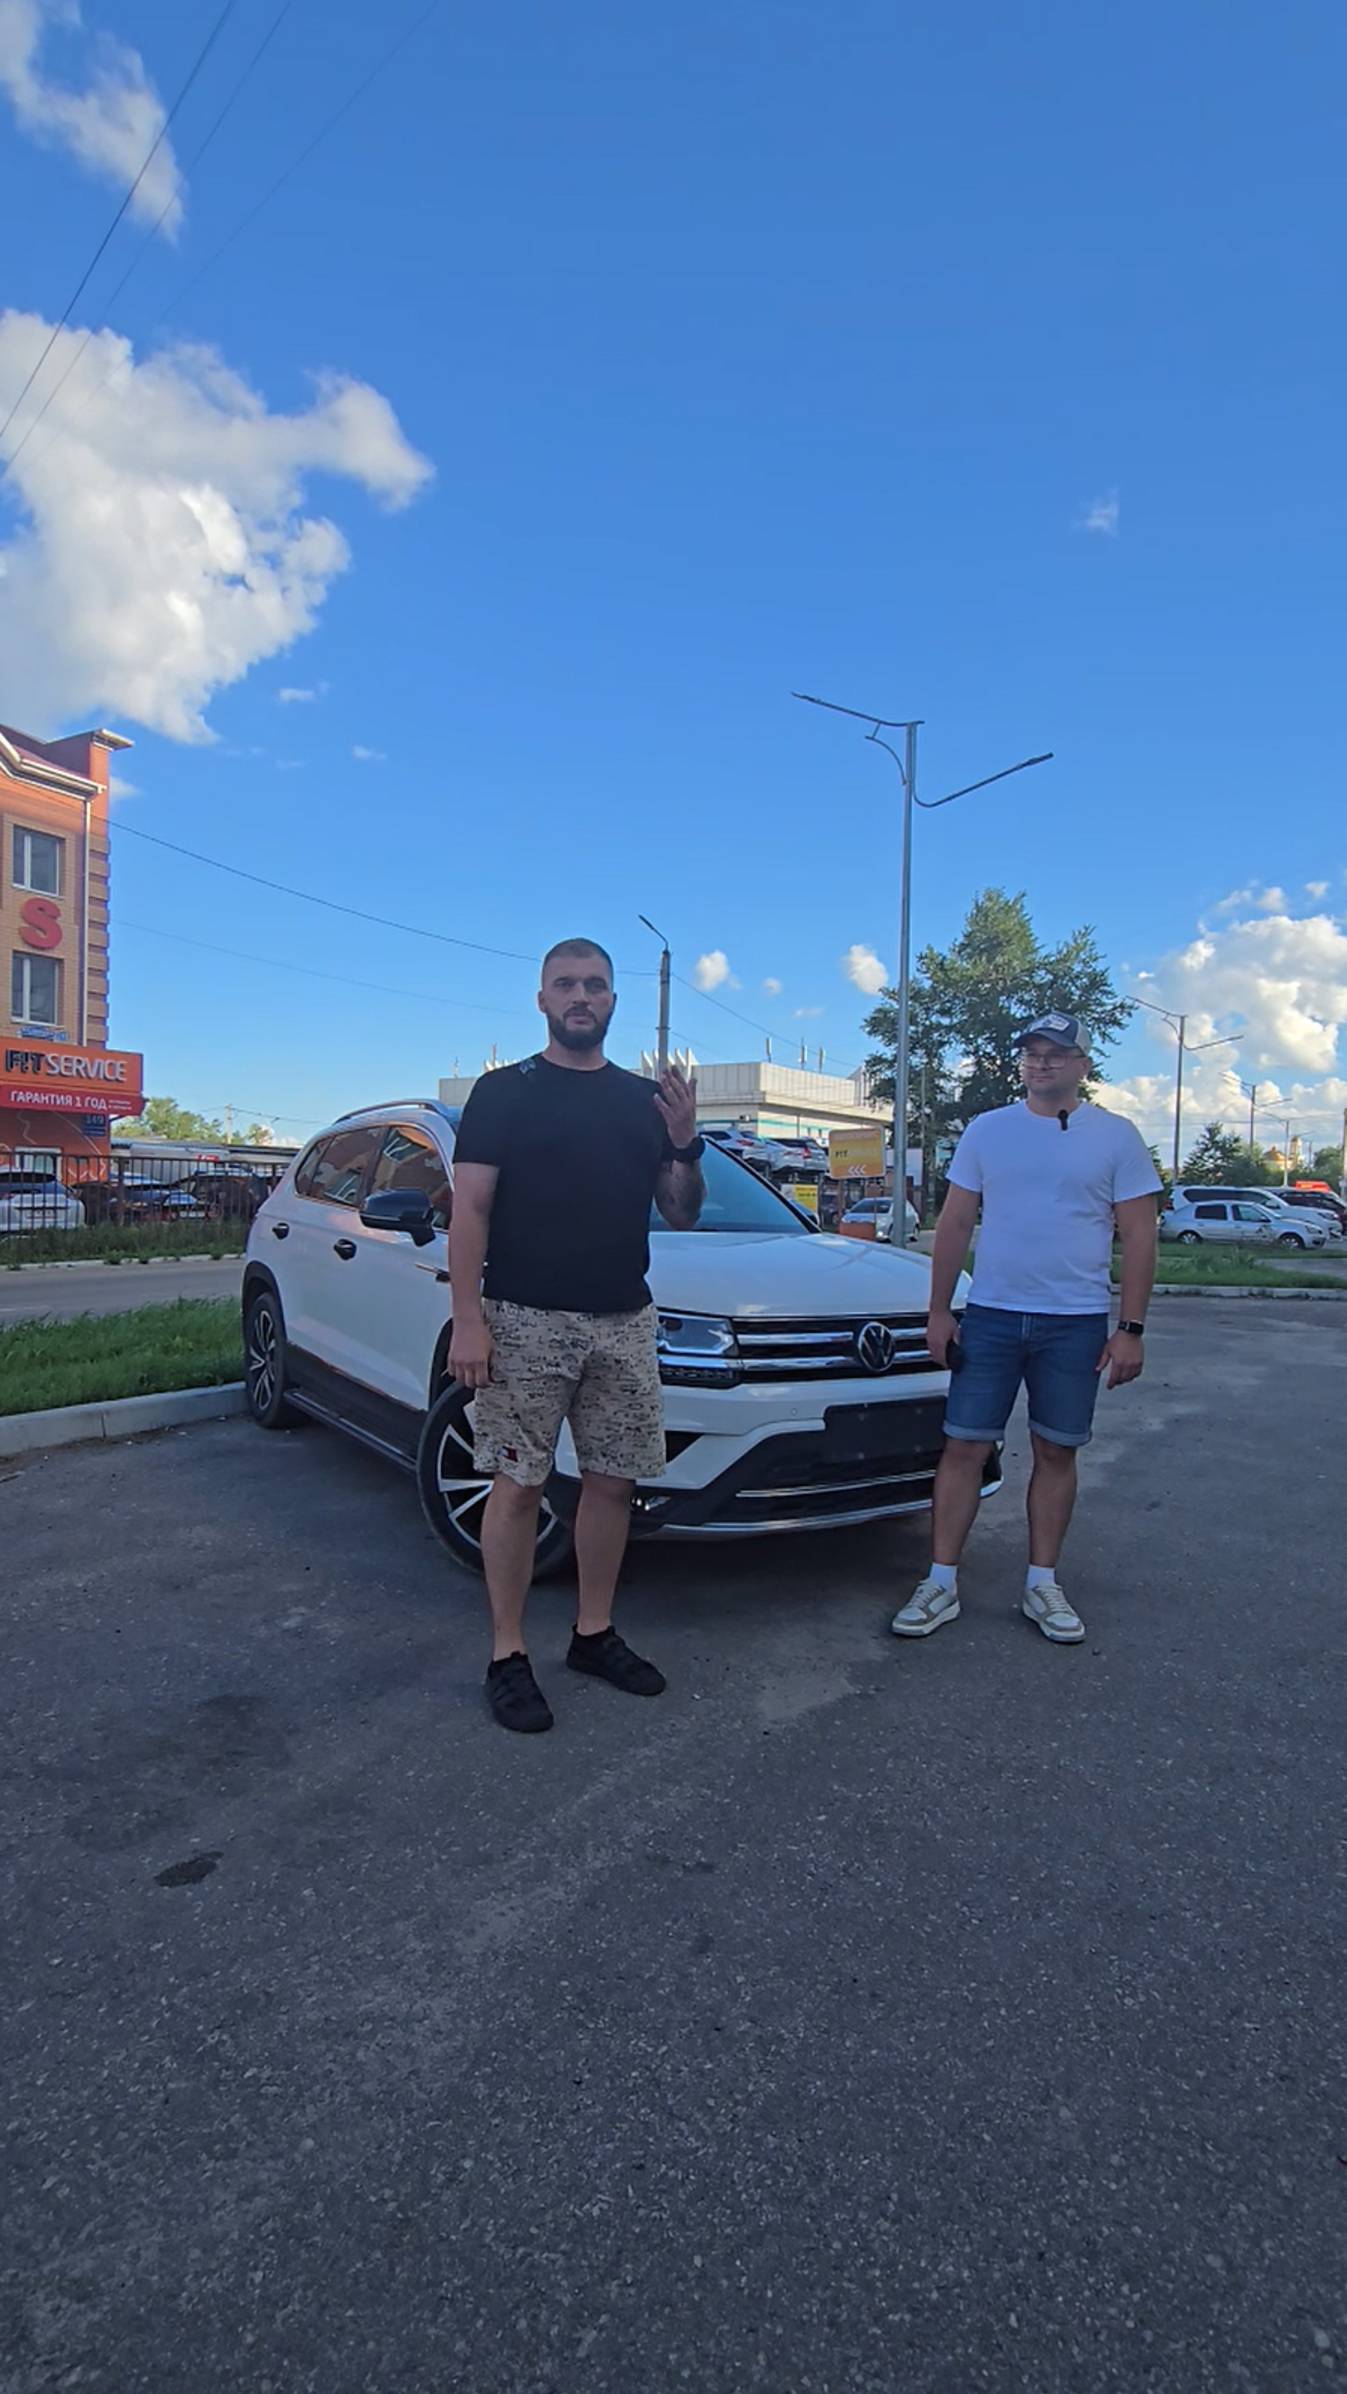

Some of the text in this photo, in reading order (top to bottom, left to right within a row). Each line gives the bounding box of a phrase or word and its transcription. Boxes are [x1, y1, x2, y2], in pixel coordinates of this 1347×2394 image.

[19, 896, 62, 950] S
[46, 1053, 128, 1082] SERVICE
[10, 1090, 73, 1106] ГАРАНТИЯ
[75, 1096, 82, 1108] 1
[84, 1097, 108, 1111] ГОД
